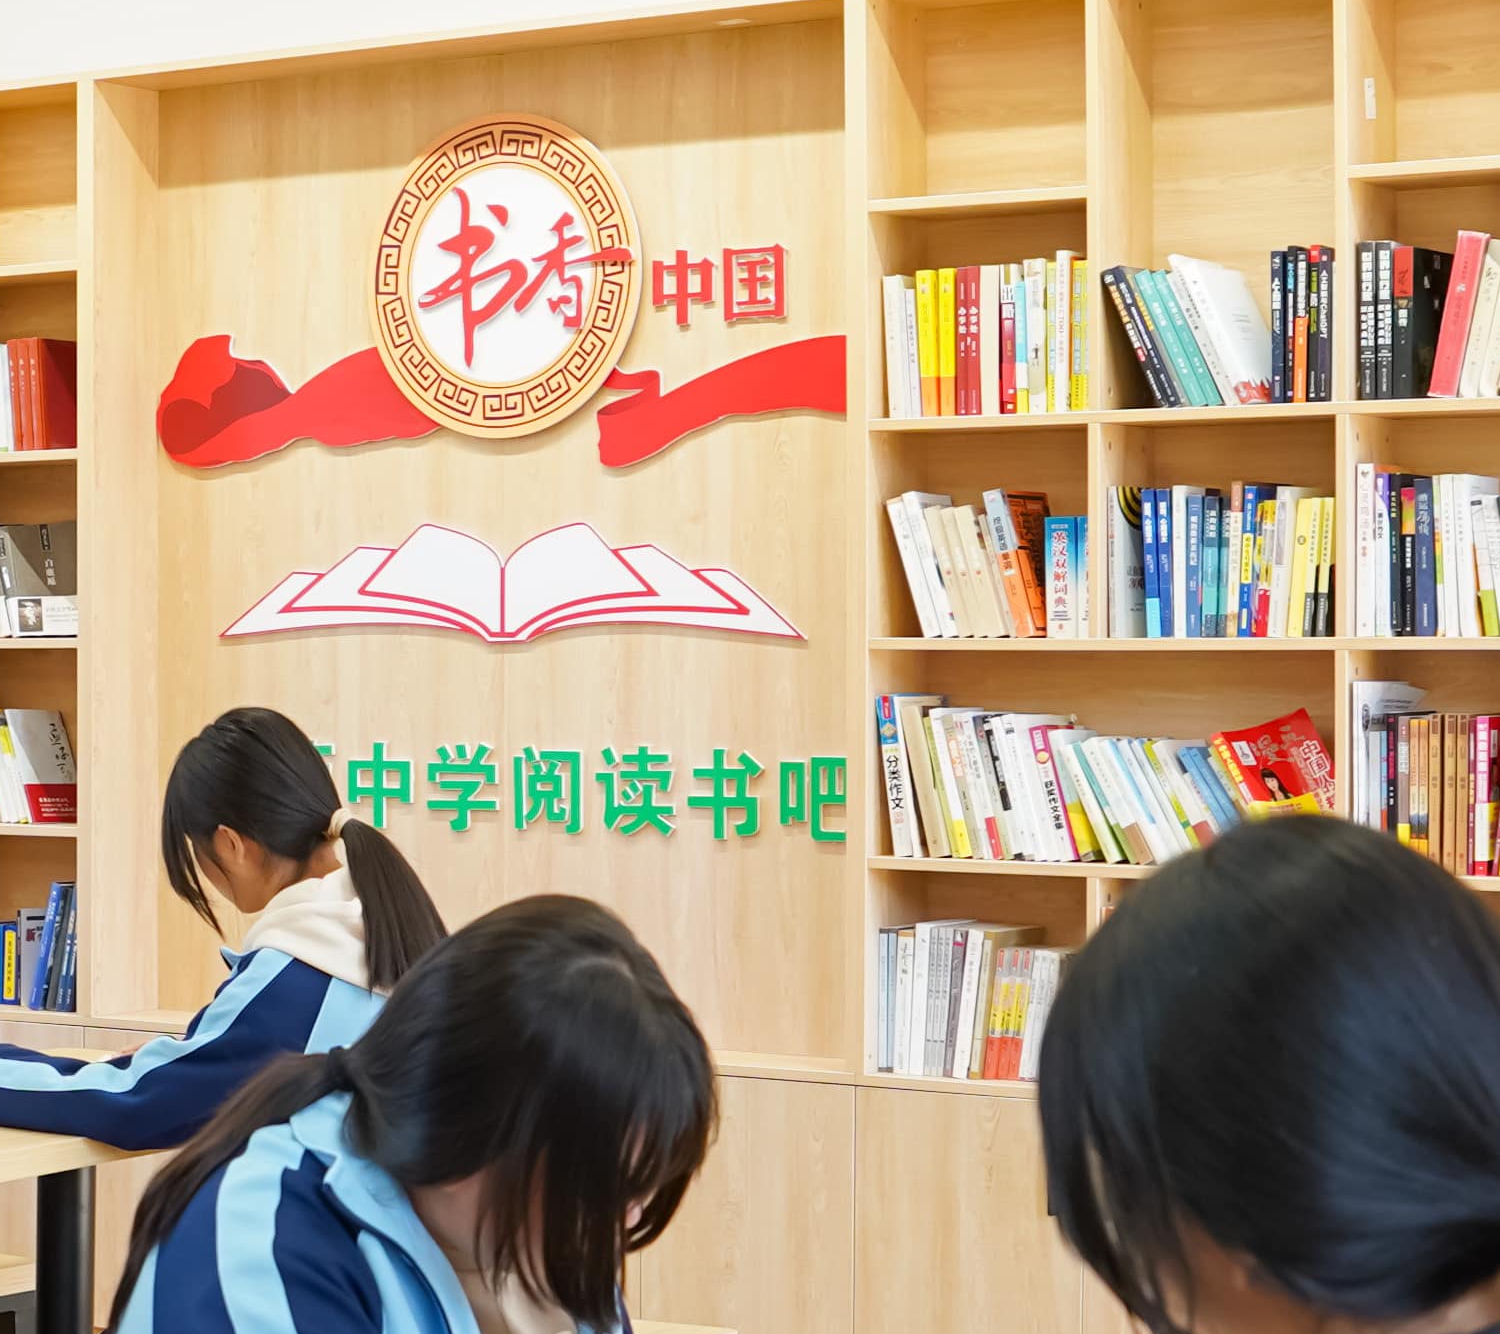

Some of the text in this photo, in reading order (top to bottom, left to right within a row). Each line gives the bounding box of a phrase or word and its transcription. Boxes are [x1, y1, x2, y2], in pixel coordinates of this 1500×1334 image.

[418, 188, 787, 367] 书香 中国
[314, 741, 848, 844] 中学阅读书吧
[885, 754, 905, 811] 分类作文
